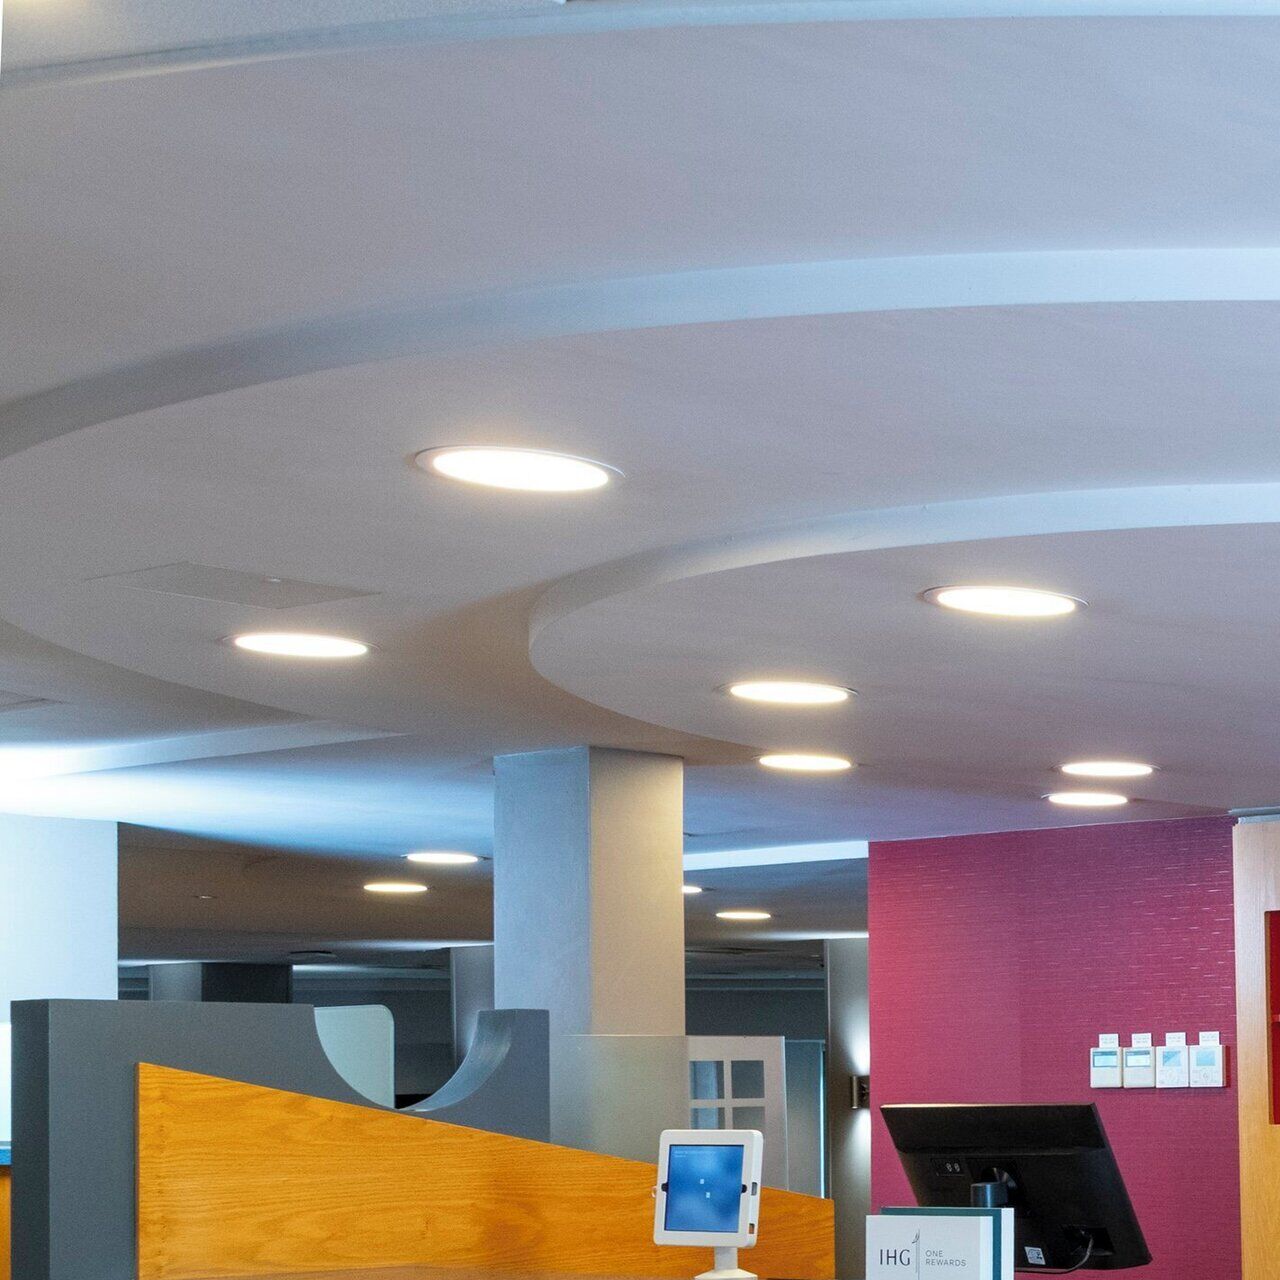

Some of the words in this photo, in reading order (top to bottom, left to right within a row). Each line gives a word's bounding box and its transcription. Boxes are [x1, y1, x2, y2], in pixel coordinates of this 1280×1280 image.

[879, 1248, 911, 1266] IHG
[926, 1250, 943, 1258] ONE
[926, 1259, 967, 1267] REWARDS
